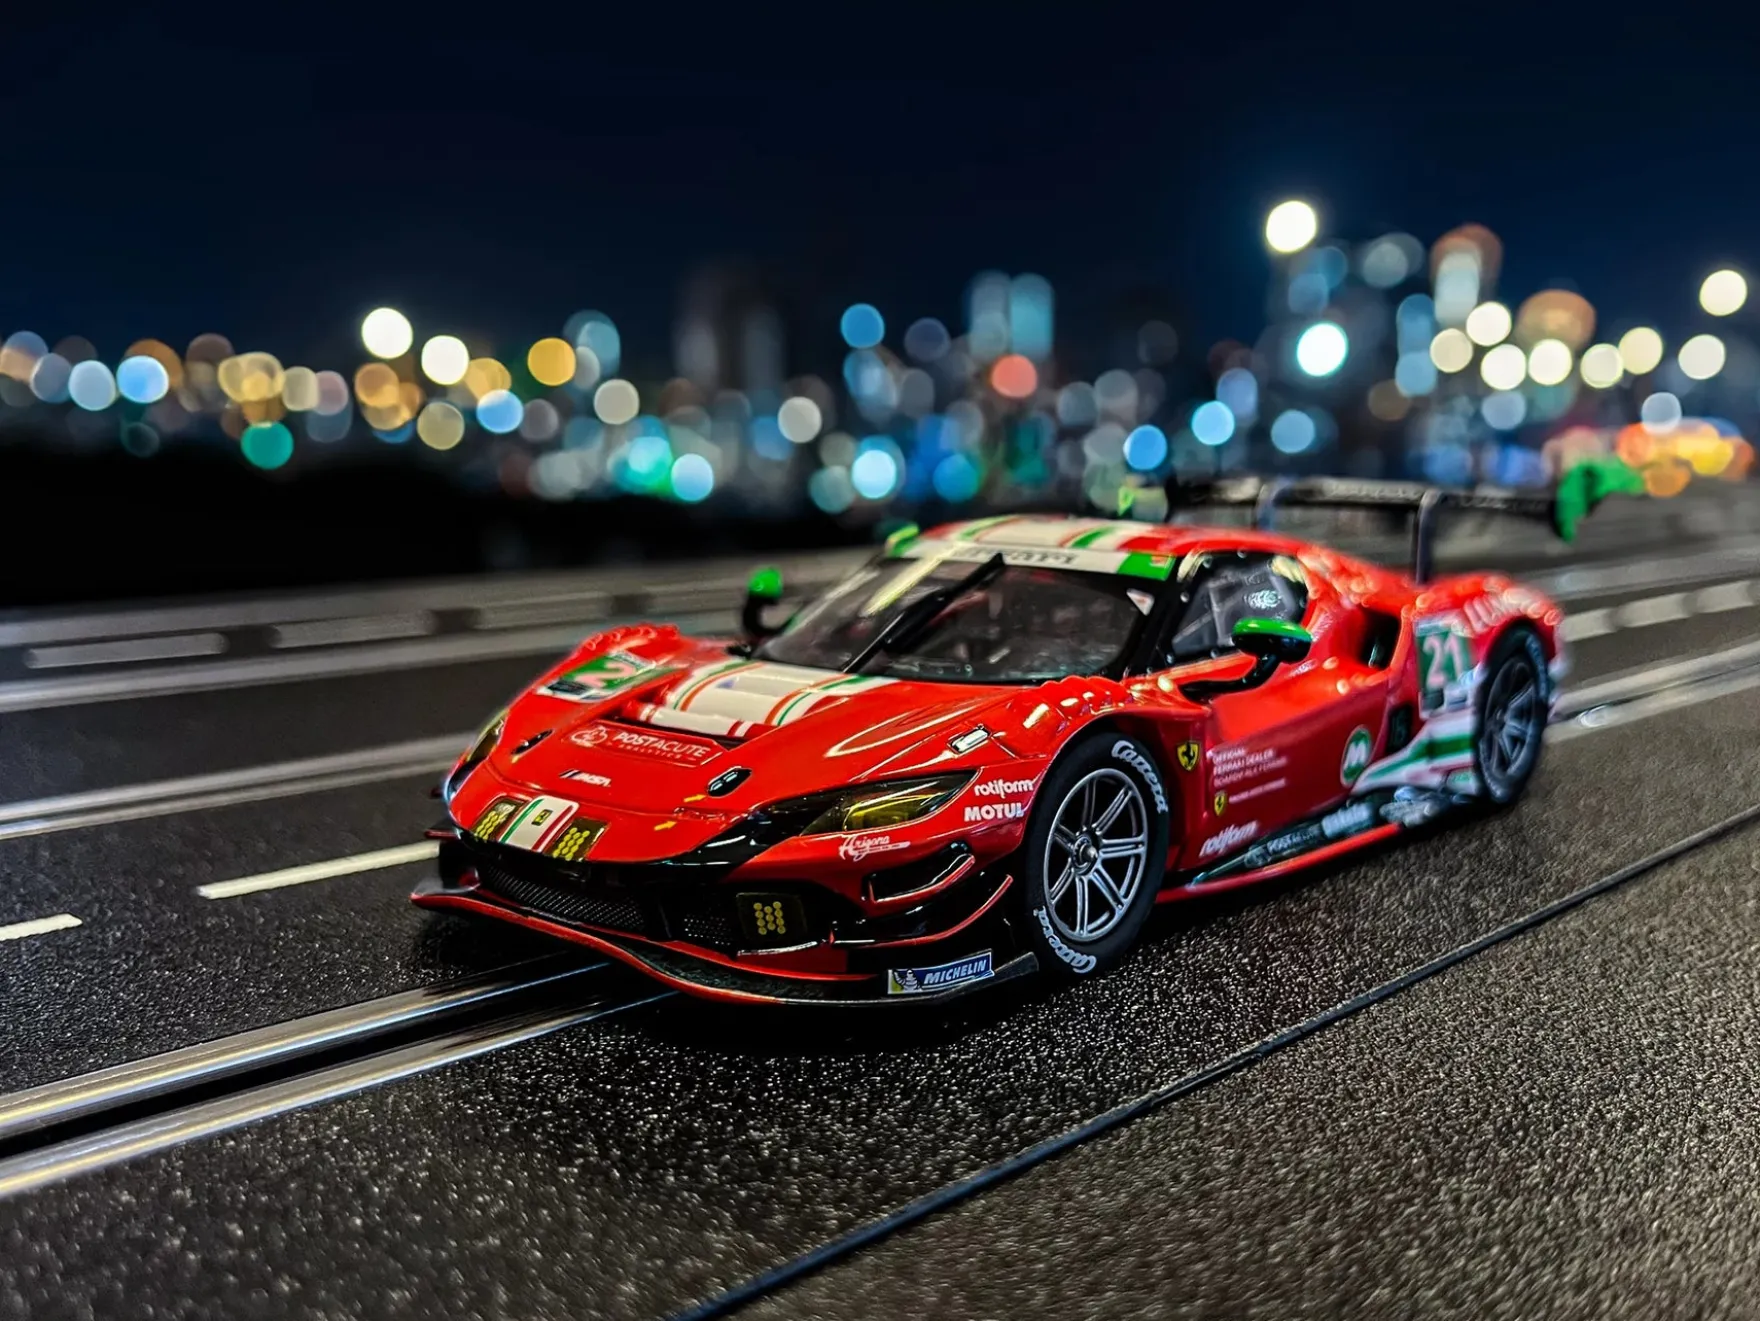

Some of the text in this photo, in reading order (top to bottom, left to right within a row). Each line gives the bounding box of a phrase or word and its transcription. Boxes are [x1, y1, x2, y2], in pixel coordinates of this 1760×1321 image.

[1422, 634, 1463, 687] 21
[612, 731, 711, 758] POSTACUTE
[974, 778, 1034, 798] rotiform
[1111, 740, 1169, 813] Carrera
[964, 803, 1024, 822] MOTUL
[1033, 905, 1096, 973] Carrera
[923, 959, 987, 985] MICHELIN
